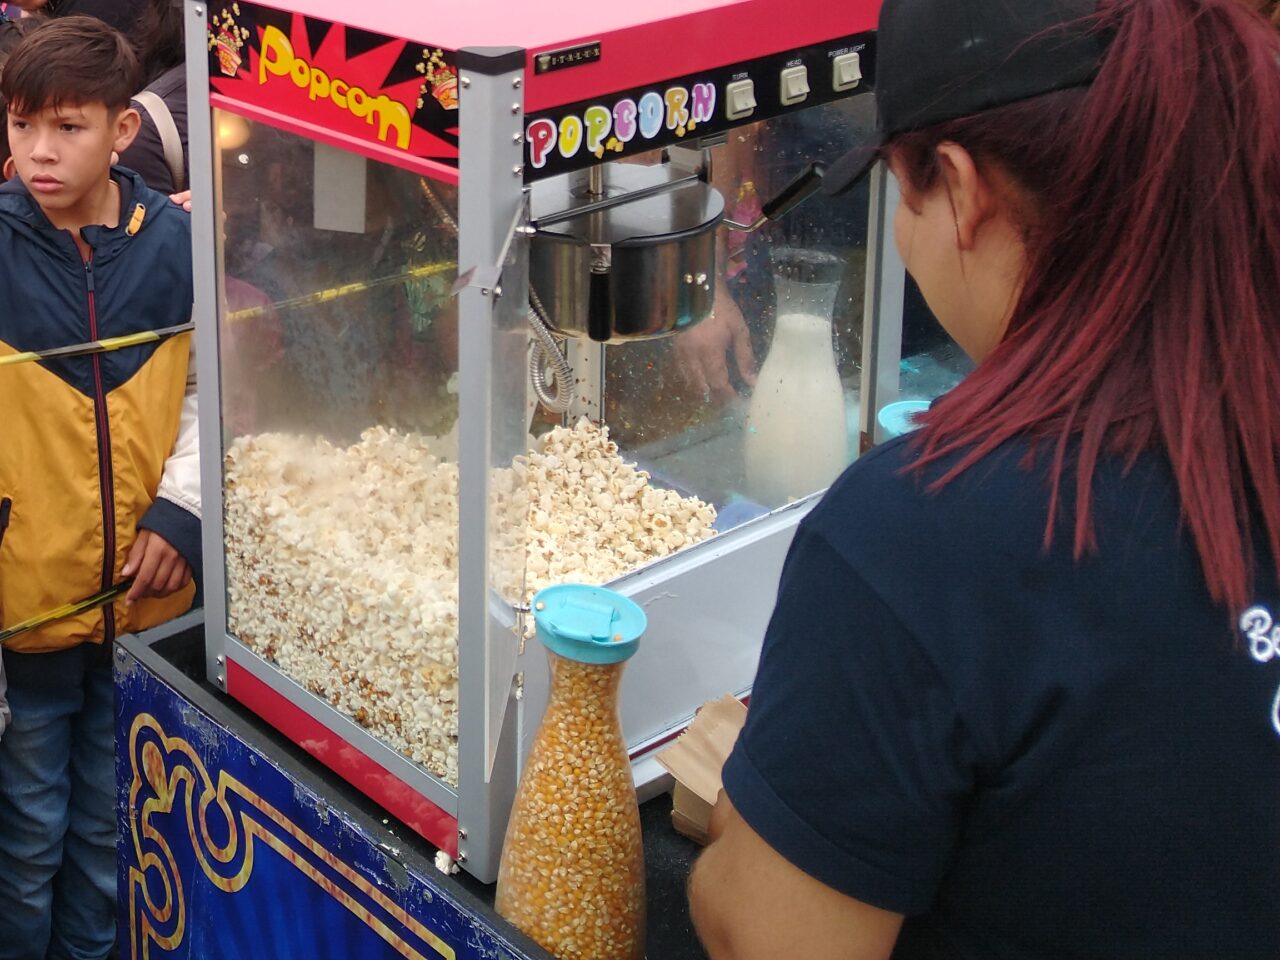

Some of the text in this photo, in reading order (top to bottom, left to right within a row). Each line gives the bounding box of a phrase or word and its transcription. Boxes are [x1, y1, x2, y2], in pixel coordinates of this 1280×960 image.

[731, 71, 749, 81] TURN
[827, 43, 866, 58] POWER LIGHT
[259, 24, 412, 151] Popcorn
[526, 82, 717, 169] POPCORN
